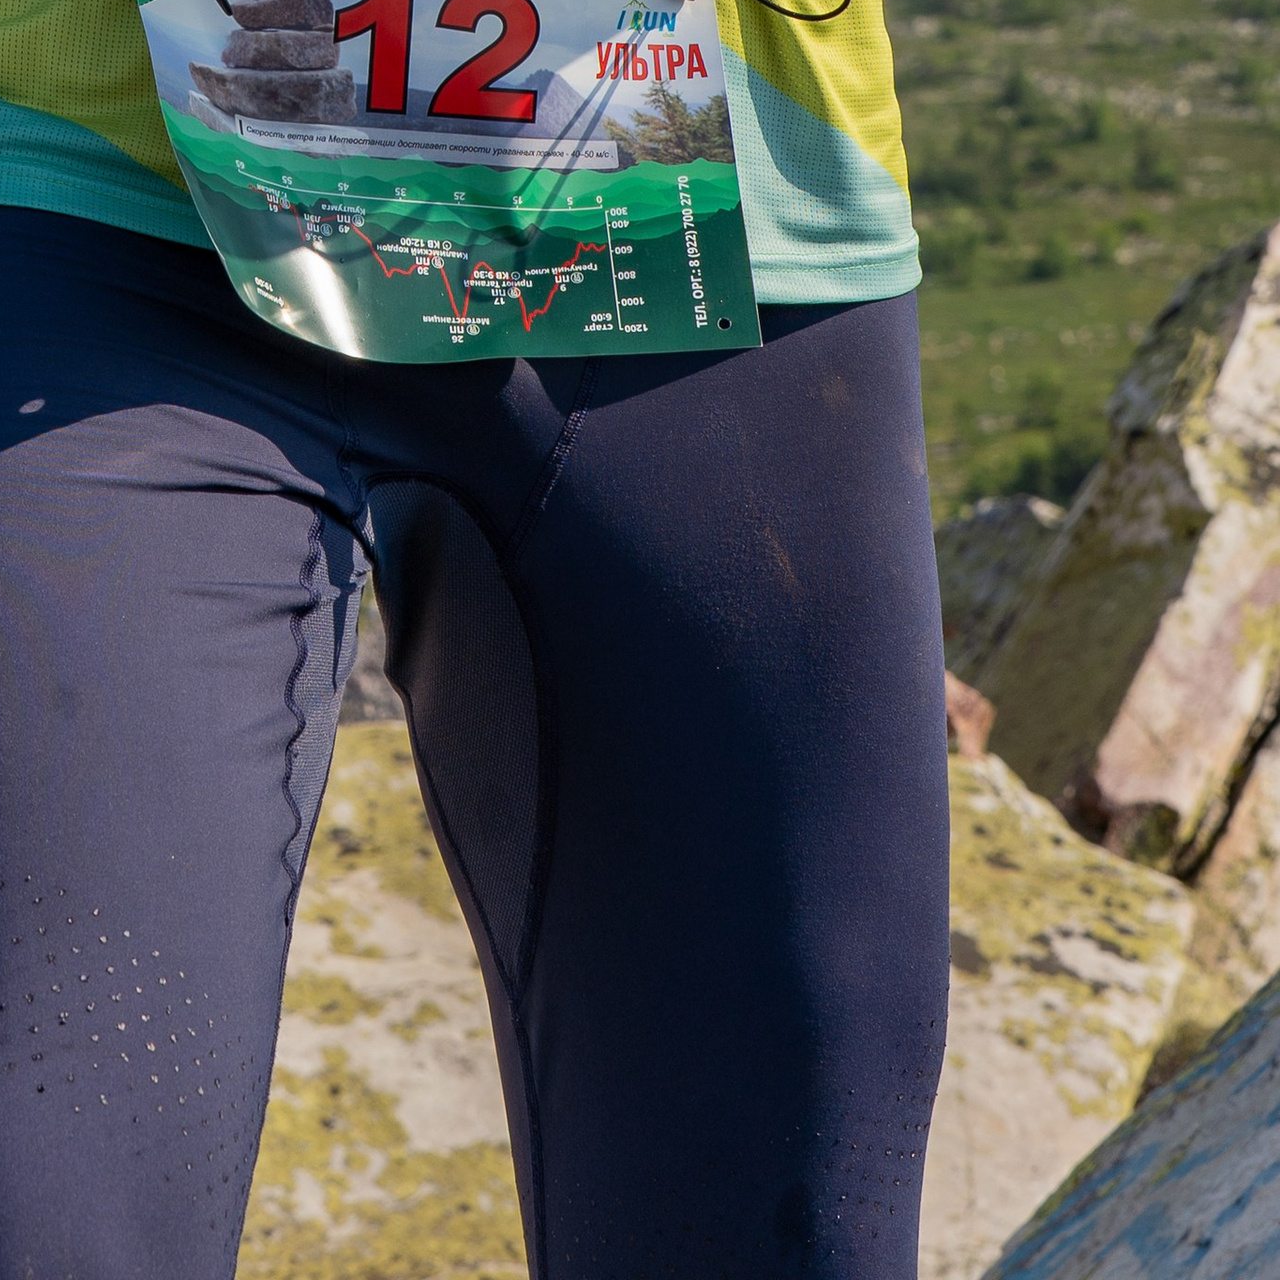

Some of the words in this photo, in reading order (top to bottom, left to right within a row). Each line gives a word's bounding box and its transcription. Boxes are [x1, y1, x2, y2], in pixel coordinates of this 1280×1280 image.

[596, 42, 708, 81] УЛЬТРА
[246, 125, 285, 140] Скорость
[287, 132, 313, 143] ветра
[316, 135, 326, 143] на
[328, 134, 396, 148] Метеостанции
[398, 139, 447, 151] достигает
[449, 144, 491, 155] скорости
[493, 146, 535, 158] ураганных
[235, 159, 246, 170] 65
[282, 175, 293, 185] 55
[338, 182, 349, 191] 45
[395, 187, 407, 197] 35
[454, 192, 465, 201] 25
[512, 196, 523, 205] 15
[567, 196, 573, 205] 5
[596, 195, 603, 204] 0
[677, 175, 689, 189] 70
[680, 192, 692, 206] 27
[269, 204, 279, 213] 61
[321, 204, 366, 216] Куштумга
[610, 207, 628, 216] 300
[304, 213, 321, 223] ЛЭП
[336, 214, 351, 224] ПП
[681, 208, 694, 228] 700
[306, 223, 320, 233] ПП
[338, 224, 350, 234] 49
[611, 220, 629, 229] 400
[400, 237, 425, 247] 12:00
[427, 240, 440, 249] КВ
[685, 231, 701, 258] (922)
[377, 244, 409, 253] кордон
[615, 245, 632, 255] 600
[411, 248, 468, 260] Киалимский
[415, 256, 430, 266] ПП
[689, 259, 700, 267] 8
[417, 267, 429, 275] 30
[525, 267, 550, 276] ключ
[552, 263, 597, 275] Гремучий
[473, 270, 494, 279] 9:30
[495, 271, 509, 280] КВ
[555, 274, 570, 284] ПП
[618, 271, 636, 280] 800
[463, 279, 500, 288] Таганай
[502, 279, 532, 288] Приют
[560, 284, 567, 292] 9
[691, 270, 704, 299] ОРГ.:
[491, 288, 506, 297] ПП
[493, 297, 505, 306] 17
[621, 297, 645, 306] 1000
[591, 313, 612, 322] 6:00
[694, 301, 708, 329] ТЕЛ.
[423, 315, 490, 325] Метеостанция
[449, 325, 464, 334] ПП
[583, 324, 613, 333] старт
[624, 323, 648, 332] 1200
[451, 335, 464, 344] 26
